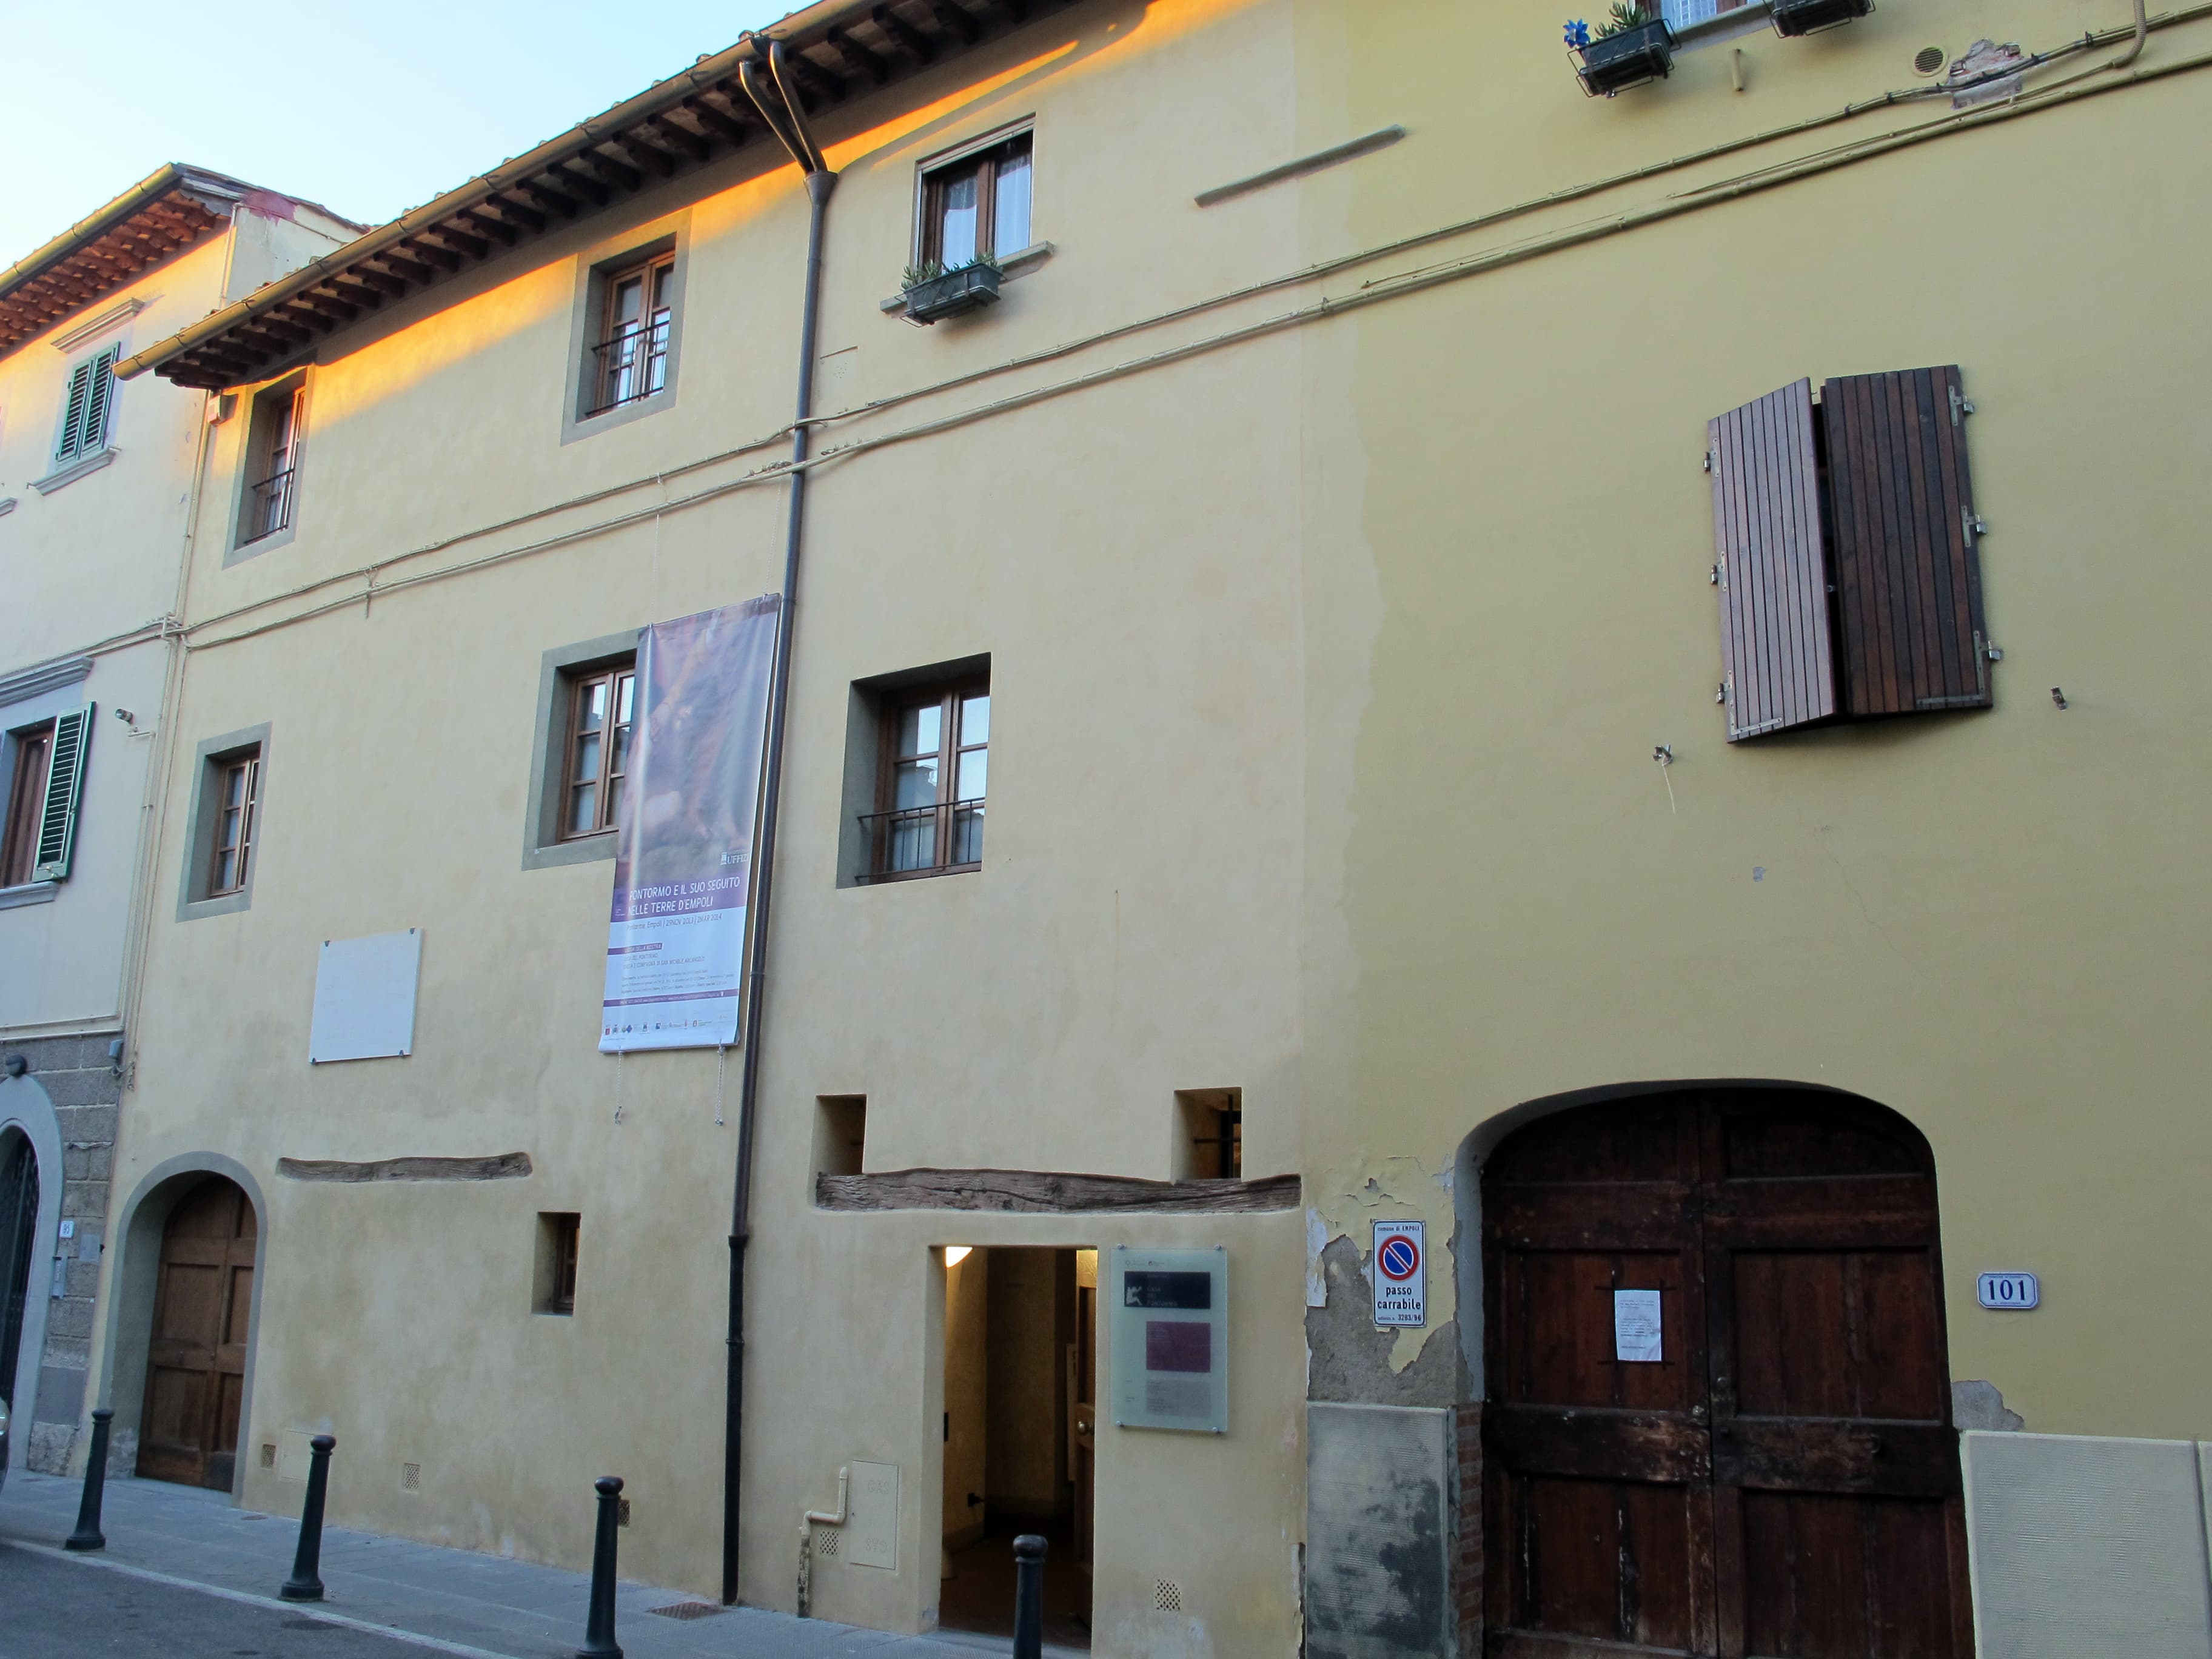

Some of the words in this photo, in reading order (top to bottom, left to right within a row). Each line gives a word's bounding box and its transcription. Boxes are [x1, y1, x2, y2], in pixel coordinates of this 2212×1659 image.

[629, 885, 671, 901] PONTORMO
[674, 885, 679, 896] E
[680, 883, 687, 895] IL
[690, 881, 705, 894] SUO
[707, 876, 740, 891] SEGUITO
[651, 900, 676, 913] TERRE
[678, 896, 714, 911] D'EMPOLI
[1386, 1287, 1412, 1297] passo
[1988, 1279, 2025, 1300] 101
[1377, 1298, 1421, 1310] carrabile
